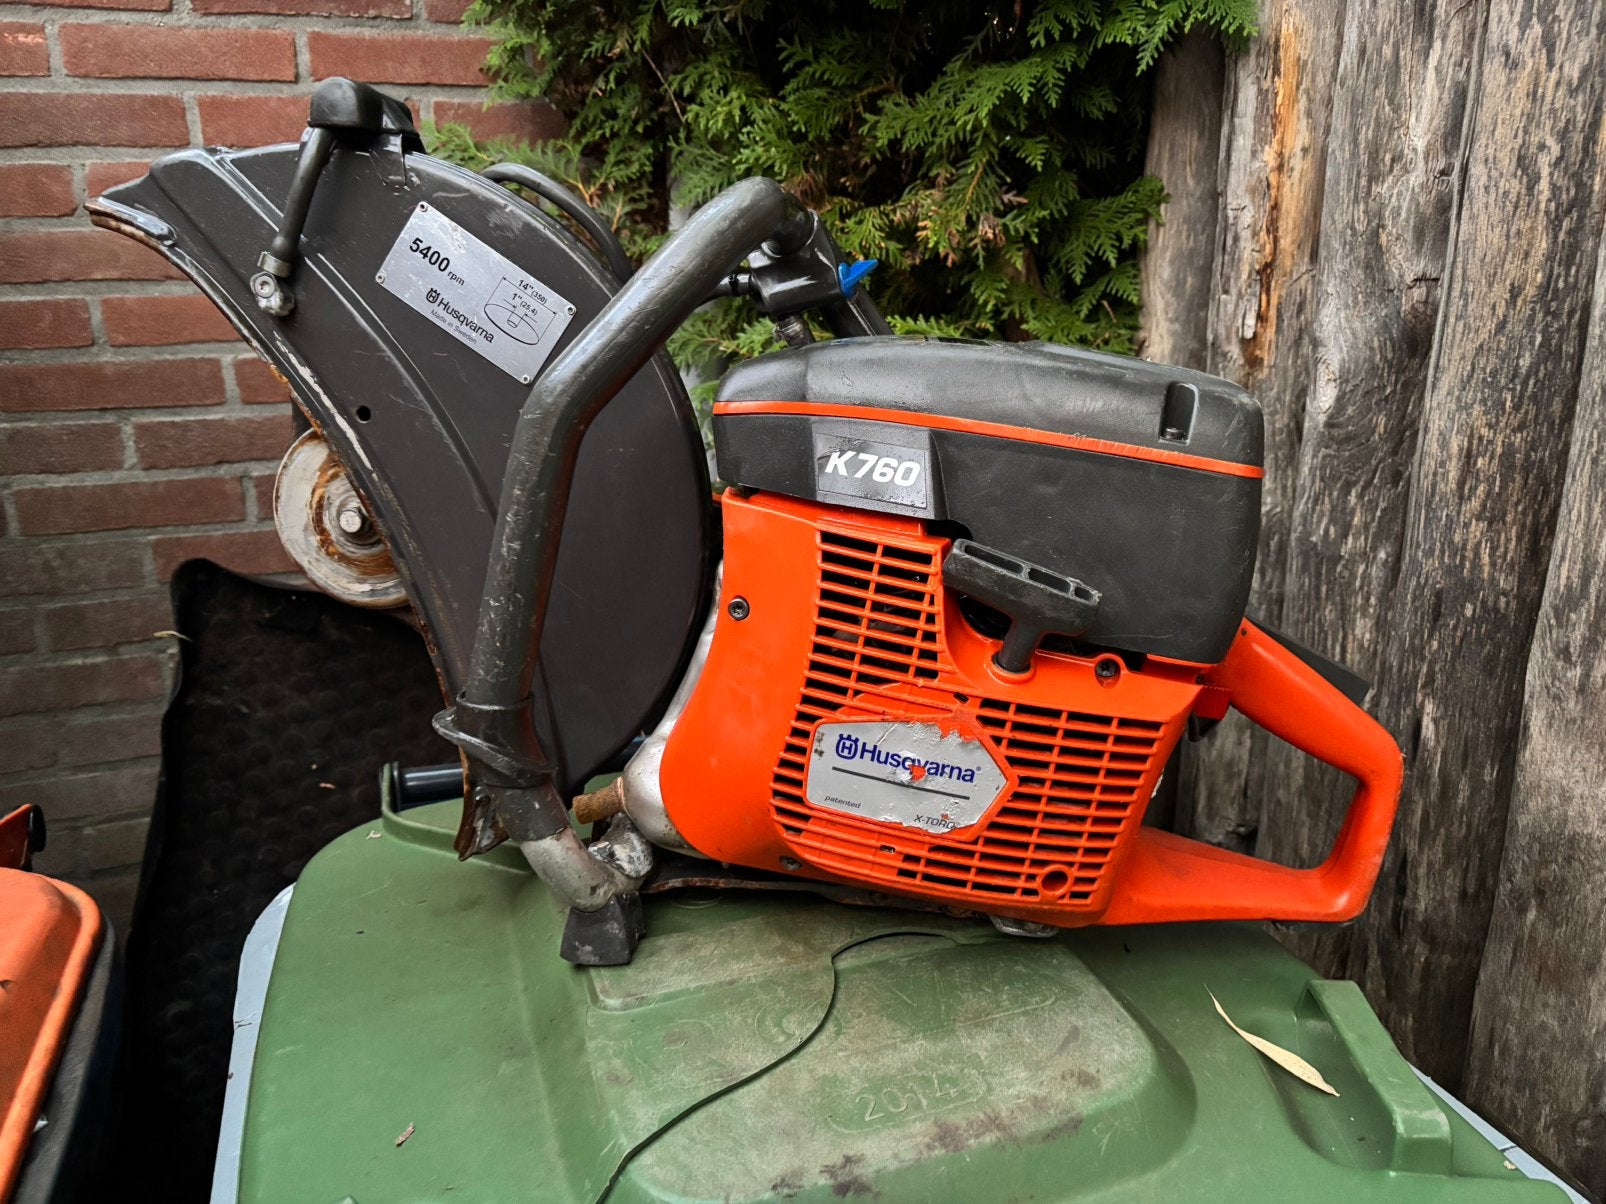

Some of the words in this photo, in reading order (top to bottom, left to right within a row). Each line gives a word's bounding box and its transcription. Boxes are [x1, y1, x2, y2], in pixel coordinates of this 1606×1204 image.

[409, 238, 450, 272] 5400
[447, 271, 465, 286] rpm
[530, 290, 548, 304] (350)
[430, 309, 447, 324] Made
[453, 325, 477, 345] Sweden
[437, 297, 495, 343] Husqvarna
[824, 794, 861, 809] patented
